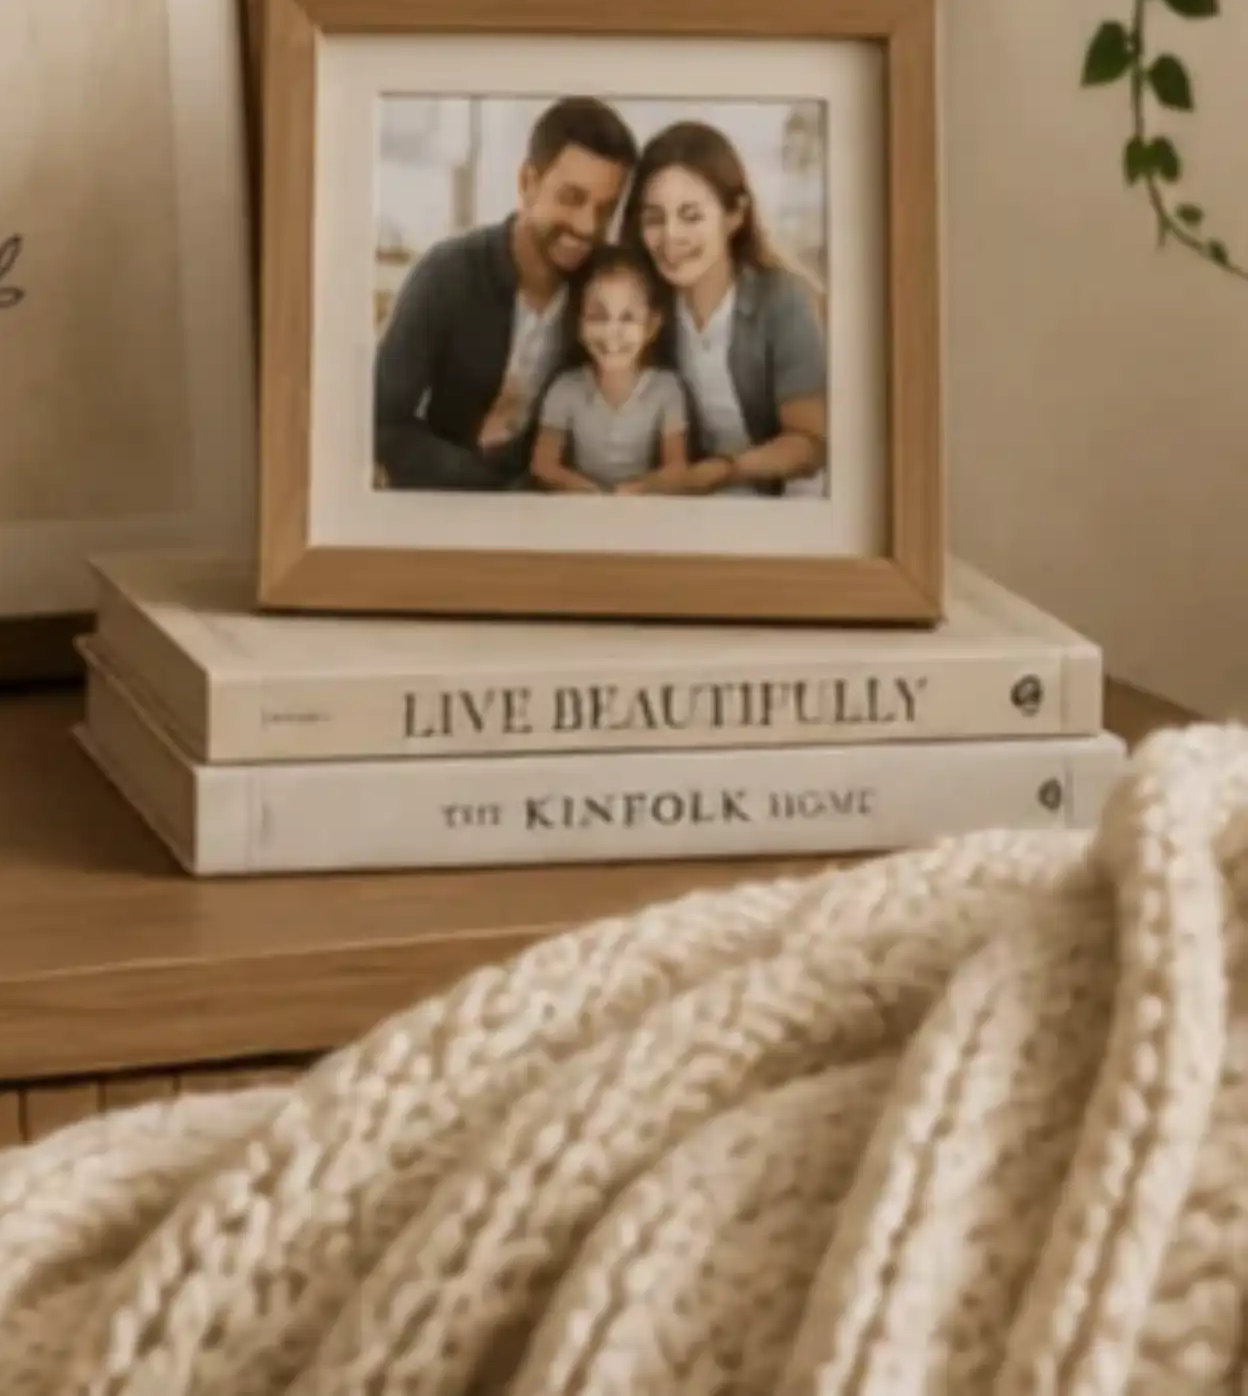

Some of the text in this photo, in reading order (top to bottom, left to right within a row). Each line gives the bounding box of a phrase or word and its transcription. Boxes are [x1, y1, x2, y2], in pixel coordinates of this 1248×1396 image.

[403, 676, 929, 738] LIVE BEAUTIFULLY
[525, 790, 752, 829] KINFOLK
